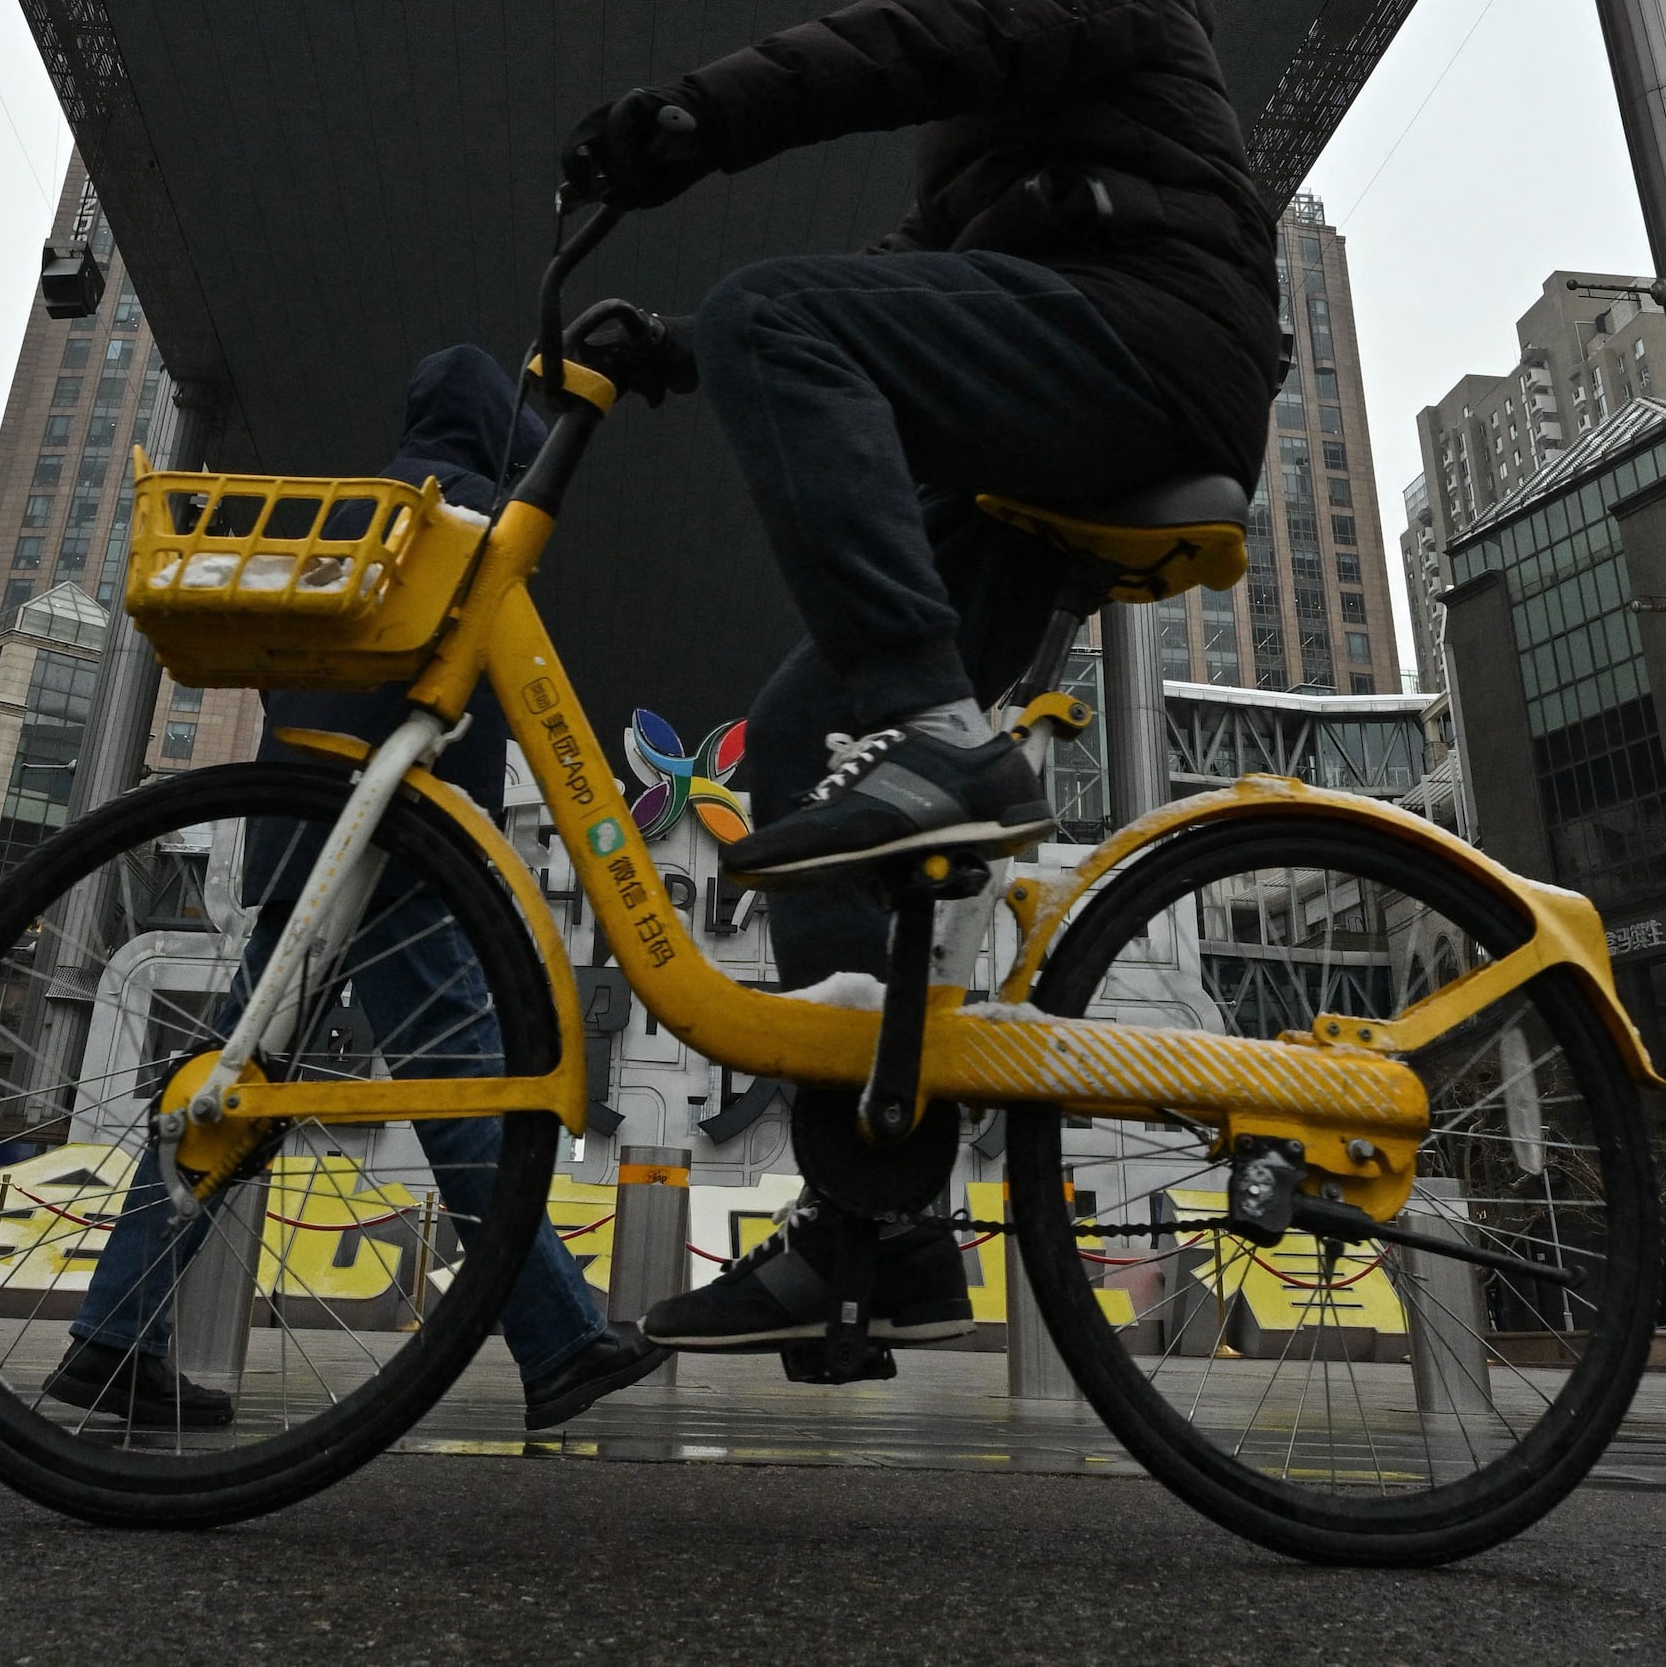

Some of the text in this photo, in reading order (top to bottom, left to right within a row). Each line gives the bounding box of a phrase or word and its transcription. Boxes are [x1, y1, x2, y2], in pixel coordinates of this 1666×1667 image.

[540, 712, 594, 805] 美团App
[607, 856, 676, 969] 微信 扫码
